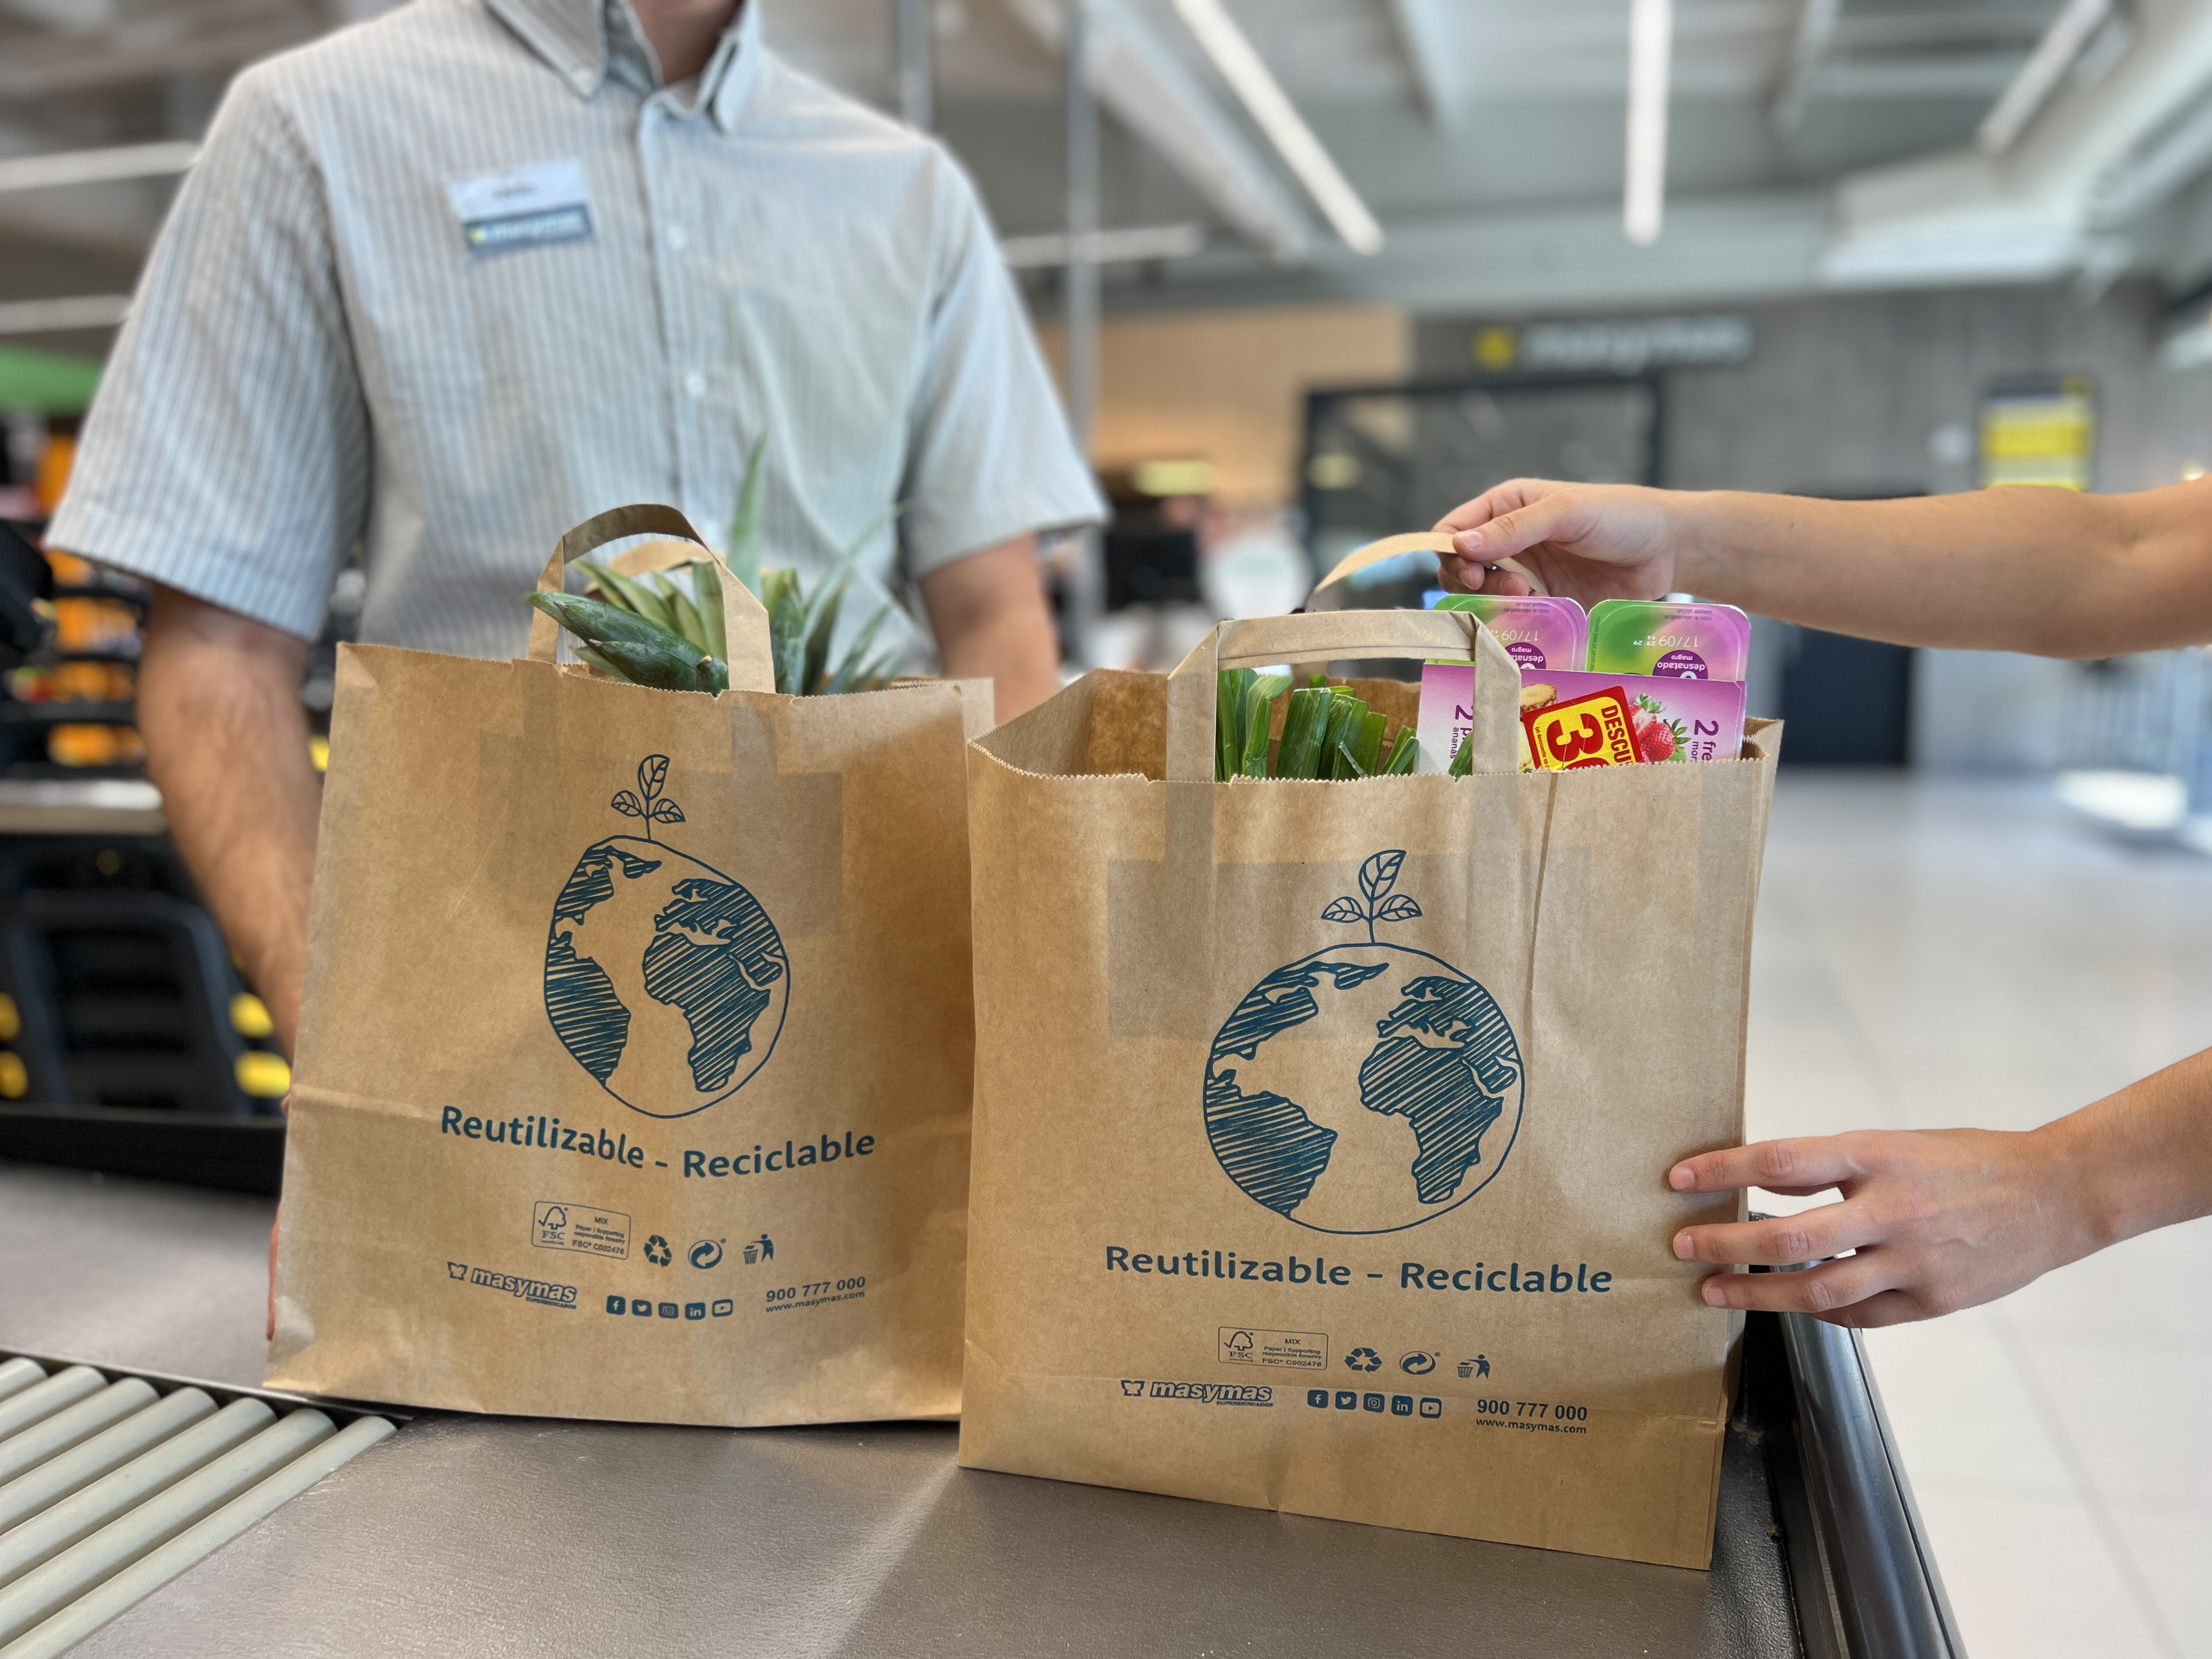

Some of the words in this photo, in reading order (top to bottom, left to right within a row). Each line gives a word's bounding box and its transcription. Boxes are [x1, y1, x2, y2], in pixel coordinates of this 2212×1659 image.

[1502, 630, 1538, 641] 17/09
[1659, 636, 1698, 647] 17/09
[1657, 662, 1705, 671] desnatado
[1455, 704, 1473, 720] 2
[1601, 705, 1633, 766] DESCU
[1694, 720, 1719, 736] 2
[442, 1106, 644, 1169] Reutilizable
[683, 1131, 875, 1179] Reciclable
[594, 1216, 608, 1225] MIX
[542, 1230, 565, 1240] FSC
[1106, 1246, 1351, 1286] Reutilizable
[1400, 1261, 1612, 1293] Reciclable
[470, 1268, 577, 1303] masymas
[766, 1287, 796, 1303] 900
[802, 1281, 832, 1297] 777
[836, 1276, 866, 1291] 000
[765, 1291, 865, 1313] www.masymas.com
[1149, 1381, 1273, 1403] masymas
[1477, 1399, 1510, 1415] 900
[1516, 1402, 1549, 1418] 777
[1555, 1405, 1587, 1421] 000
[1476, 1418, 1587, 1434] www.masymas.com
